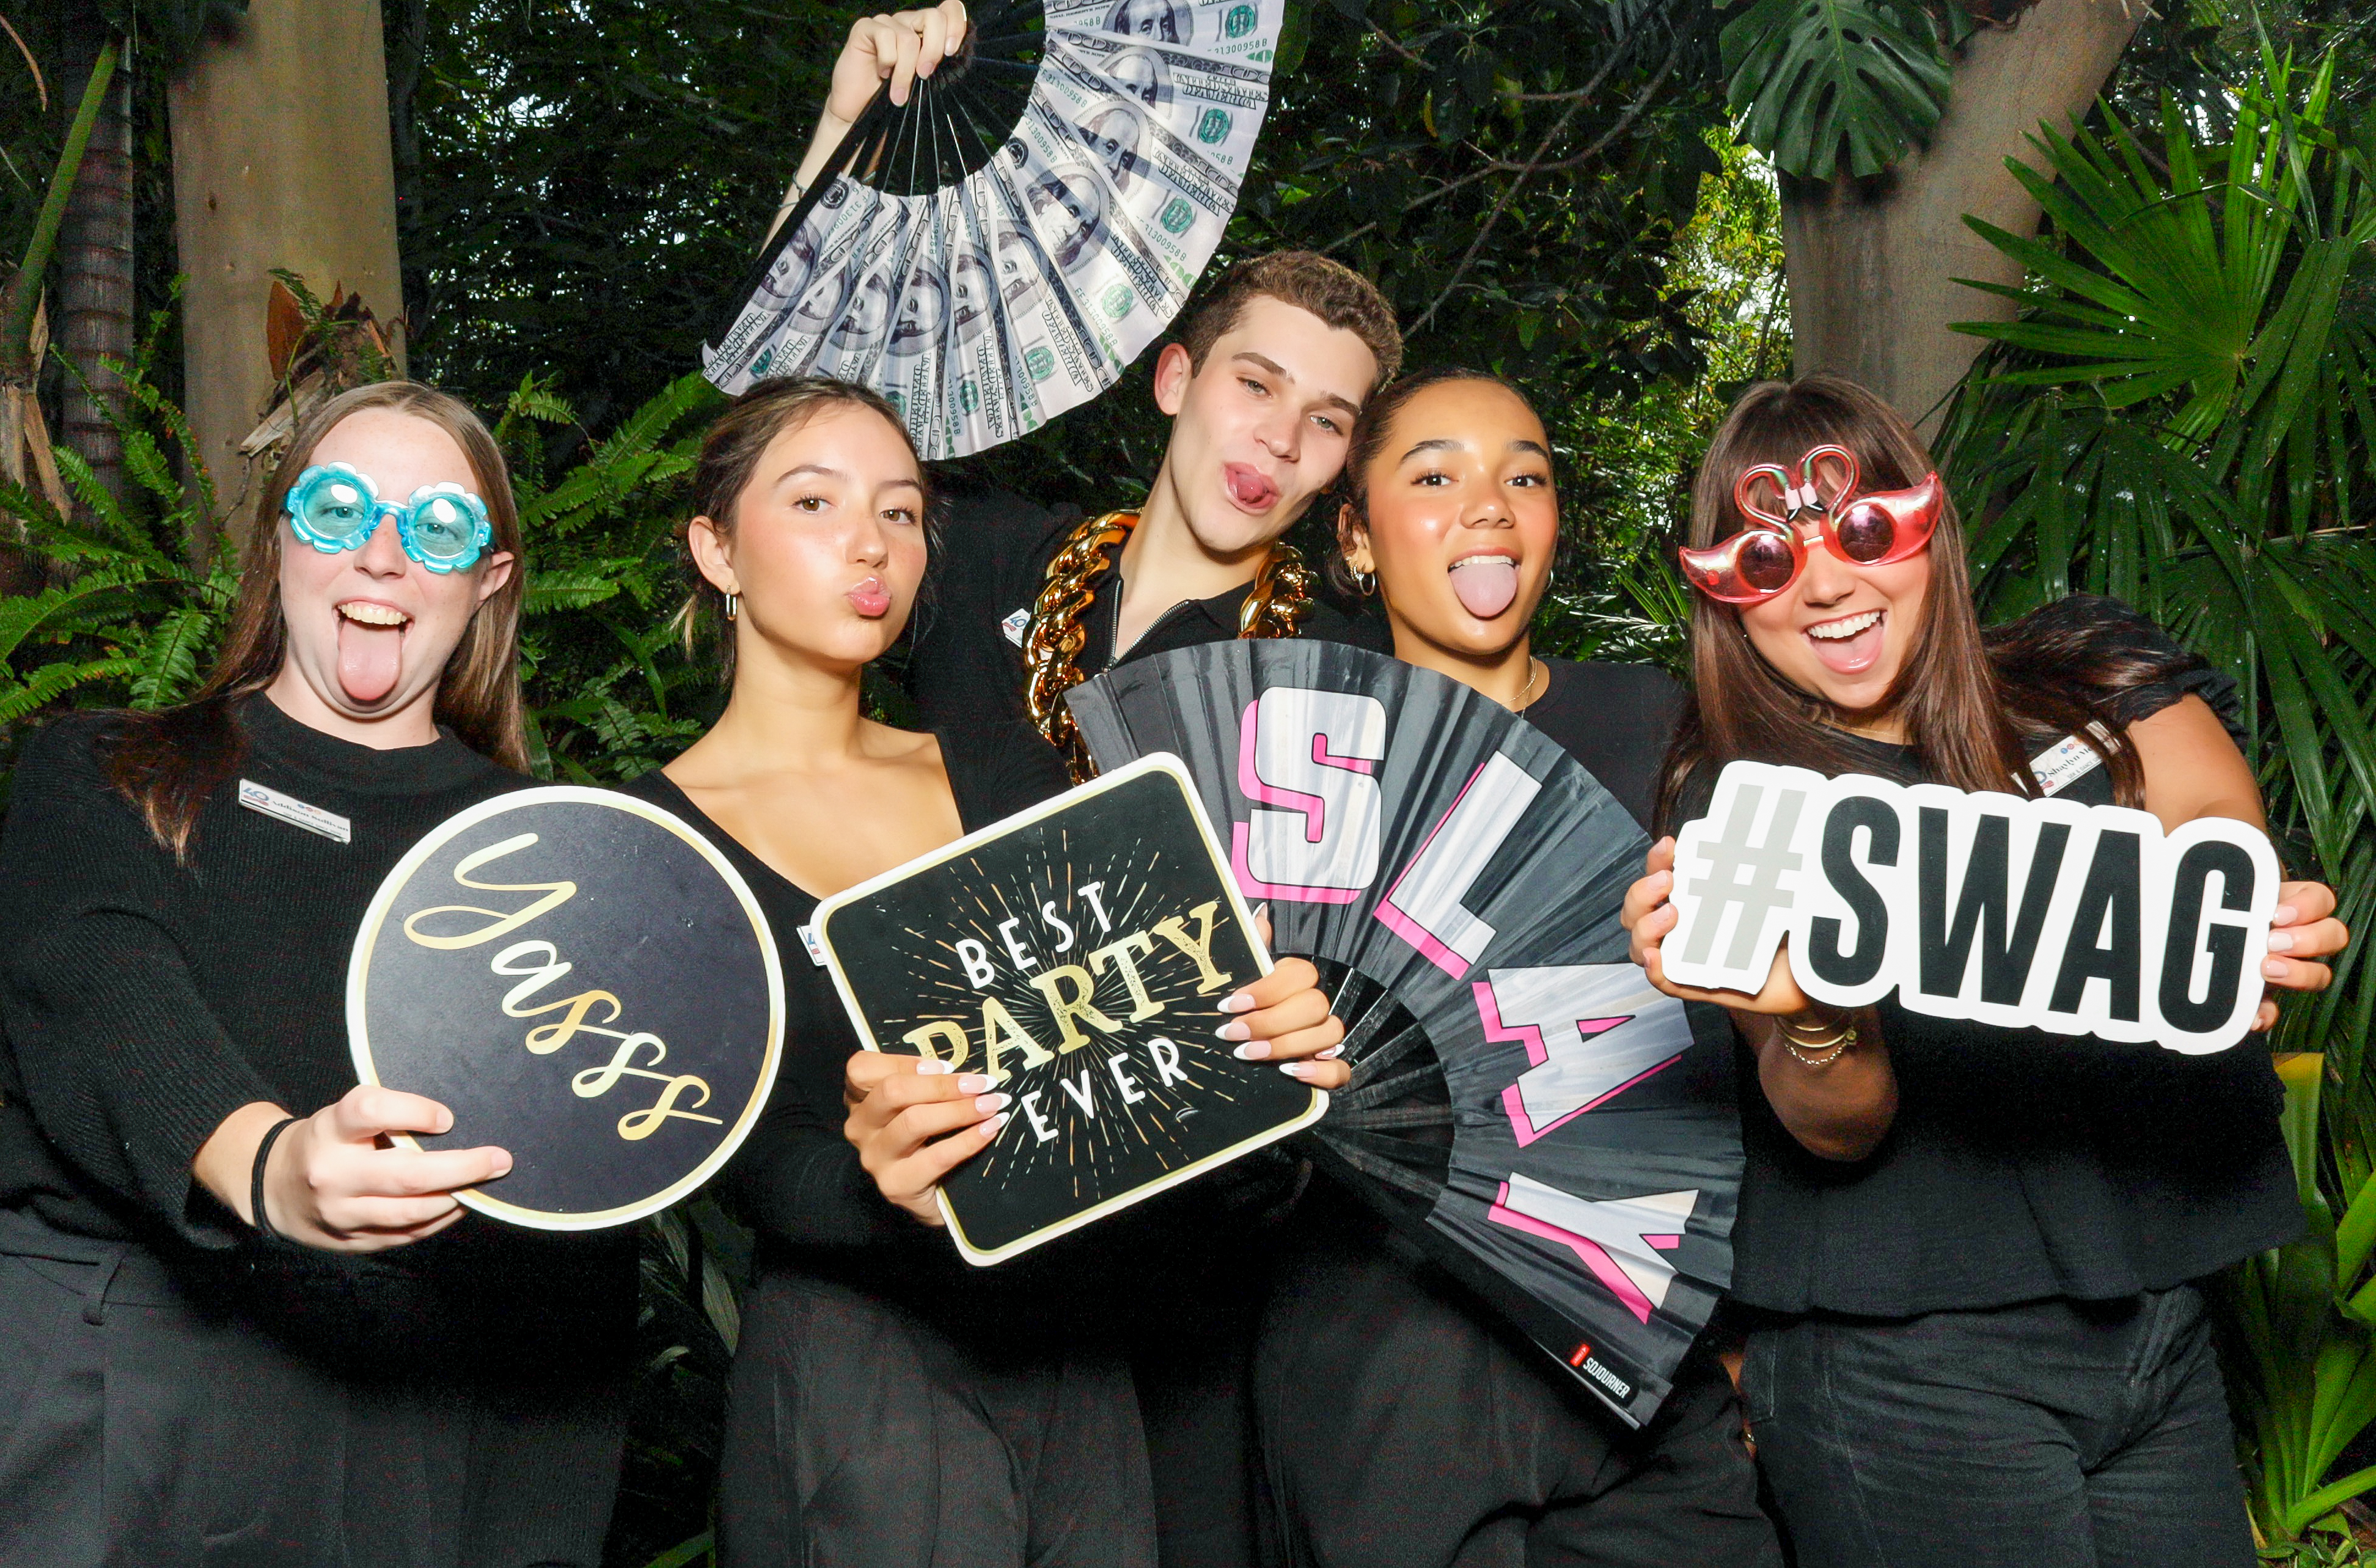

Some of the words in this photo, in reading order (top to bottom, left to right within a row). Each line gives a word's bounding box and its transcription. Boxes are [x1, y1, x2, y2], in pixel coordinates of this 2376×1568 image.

[403, 832, 723, 1141] Yasss
[903, 901, 1233, 1083] PARTY
[955, 881, 1112, 989] BEST
[1681, 783, 2255, 1034] #SWAG
[1021, 1038, 1189, 1143] EVER
[1231, 686, 1700, 1325] SLAY
[1583, 1357, 1630, 1399] SOJOURNER
